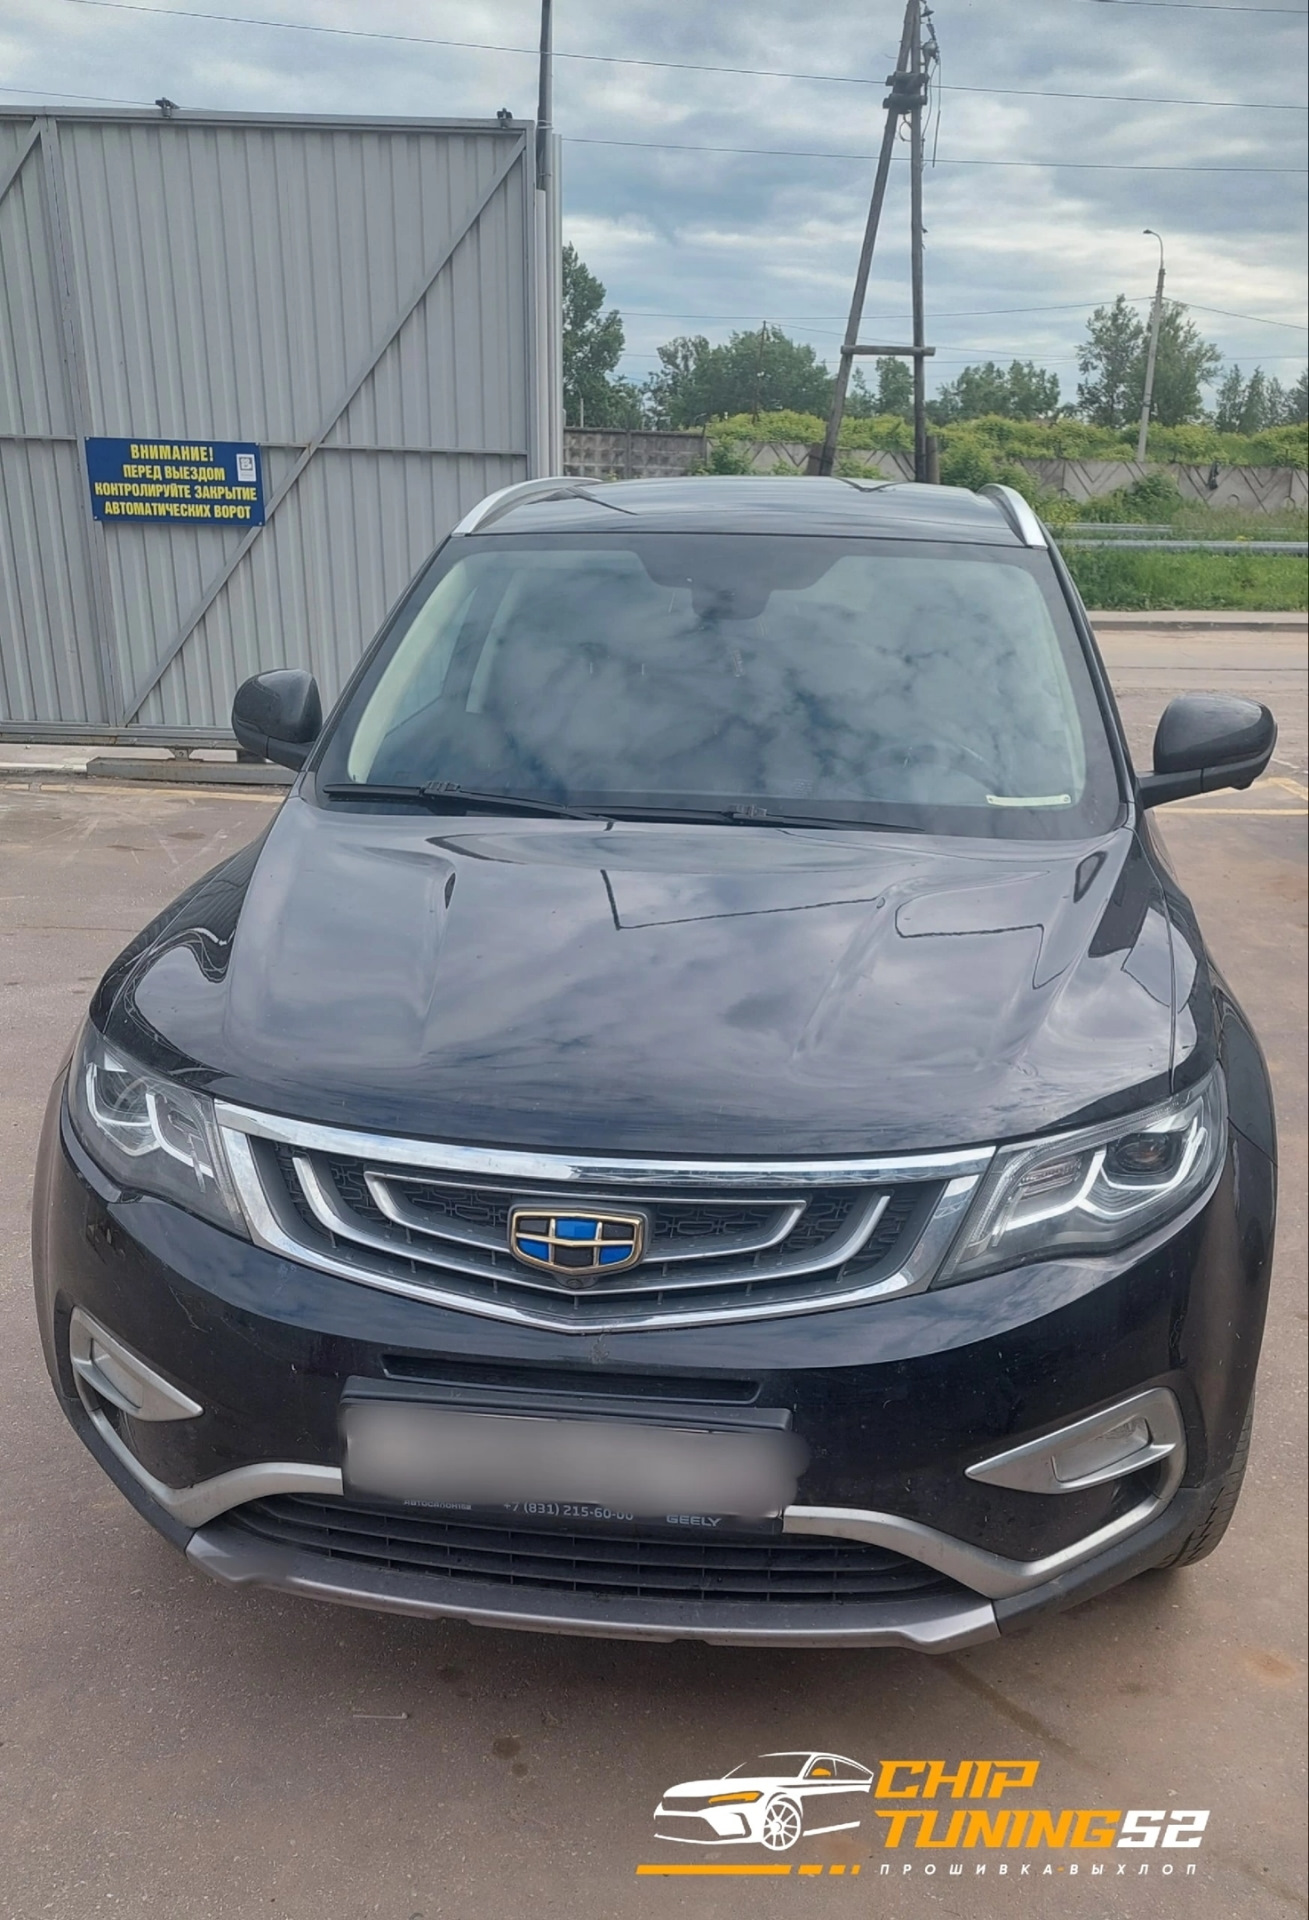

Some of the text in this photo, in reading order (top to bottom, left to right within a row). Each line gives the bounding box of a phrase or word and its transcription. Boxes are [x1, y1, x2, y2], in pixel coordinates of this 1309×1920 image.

[130, 444, 214, 462] ВНИМАНИЕ!
[123, 464, 162, 481] ПЕРЕД
[165, 466, 225, 482] ВЫЕЗДОМ
[94, 482, 257, 501] КОНТРОЛИРУЙТЕ ЗАКРЫТИЕ
[104, 501, 251, 519] АВТОМАТИЧЕСКИХ ВОРОТ
[523, 1503, 560, 1516] (831)
[666, 1515, 722, 1527] GEELY
